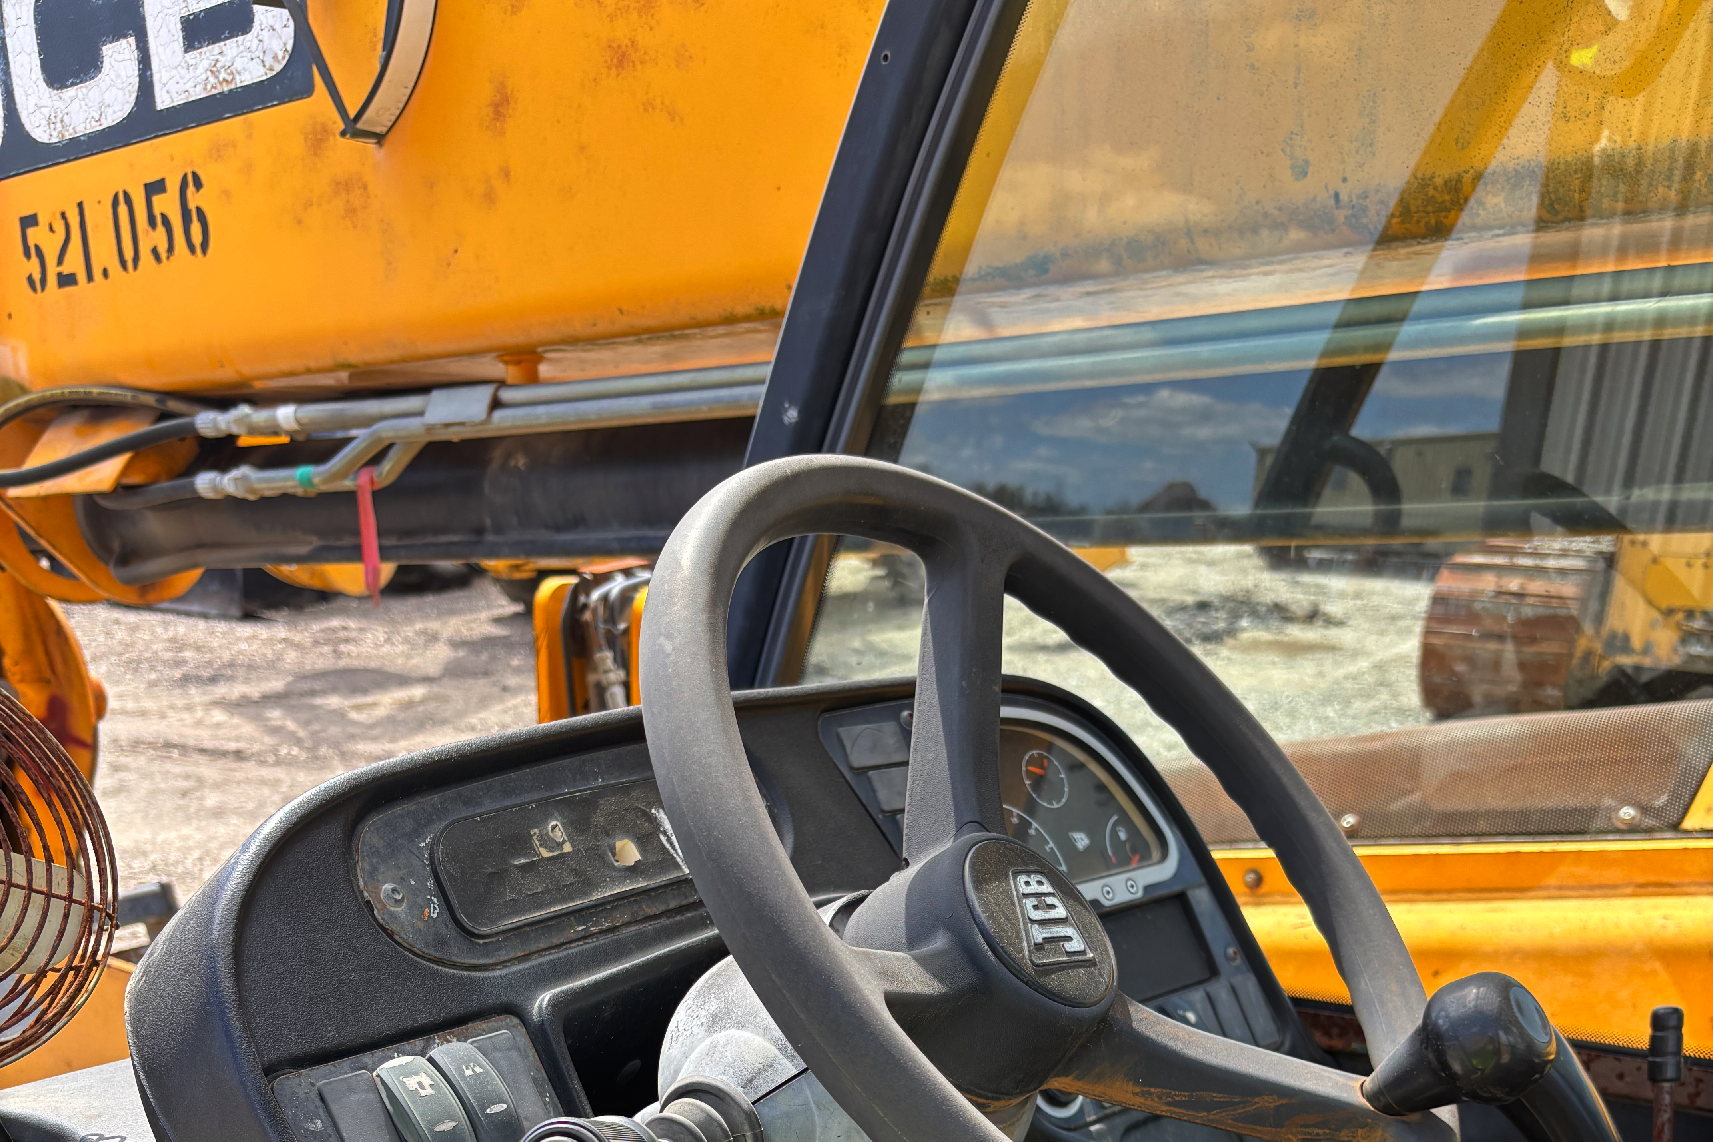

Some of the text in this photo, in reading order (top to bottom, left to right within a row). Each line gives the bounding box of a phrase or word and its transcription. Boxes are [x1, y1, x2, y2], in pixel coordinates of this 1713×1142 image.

[0, 0, 295, 144] CB
[19, 170, 210, 294] 521.056
[1017, 874, 1085, 953] JCB
